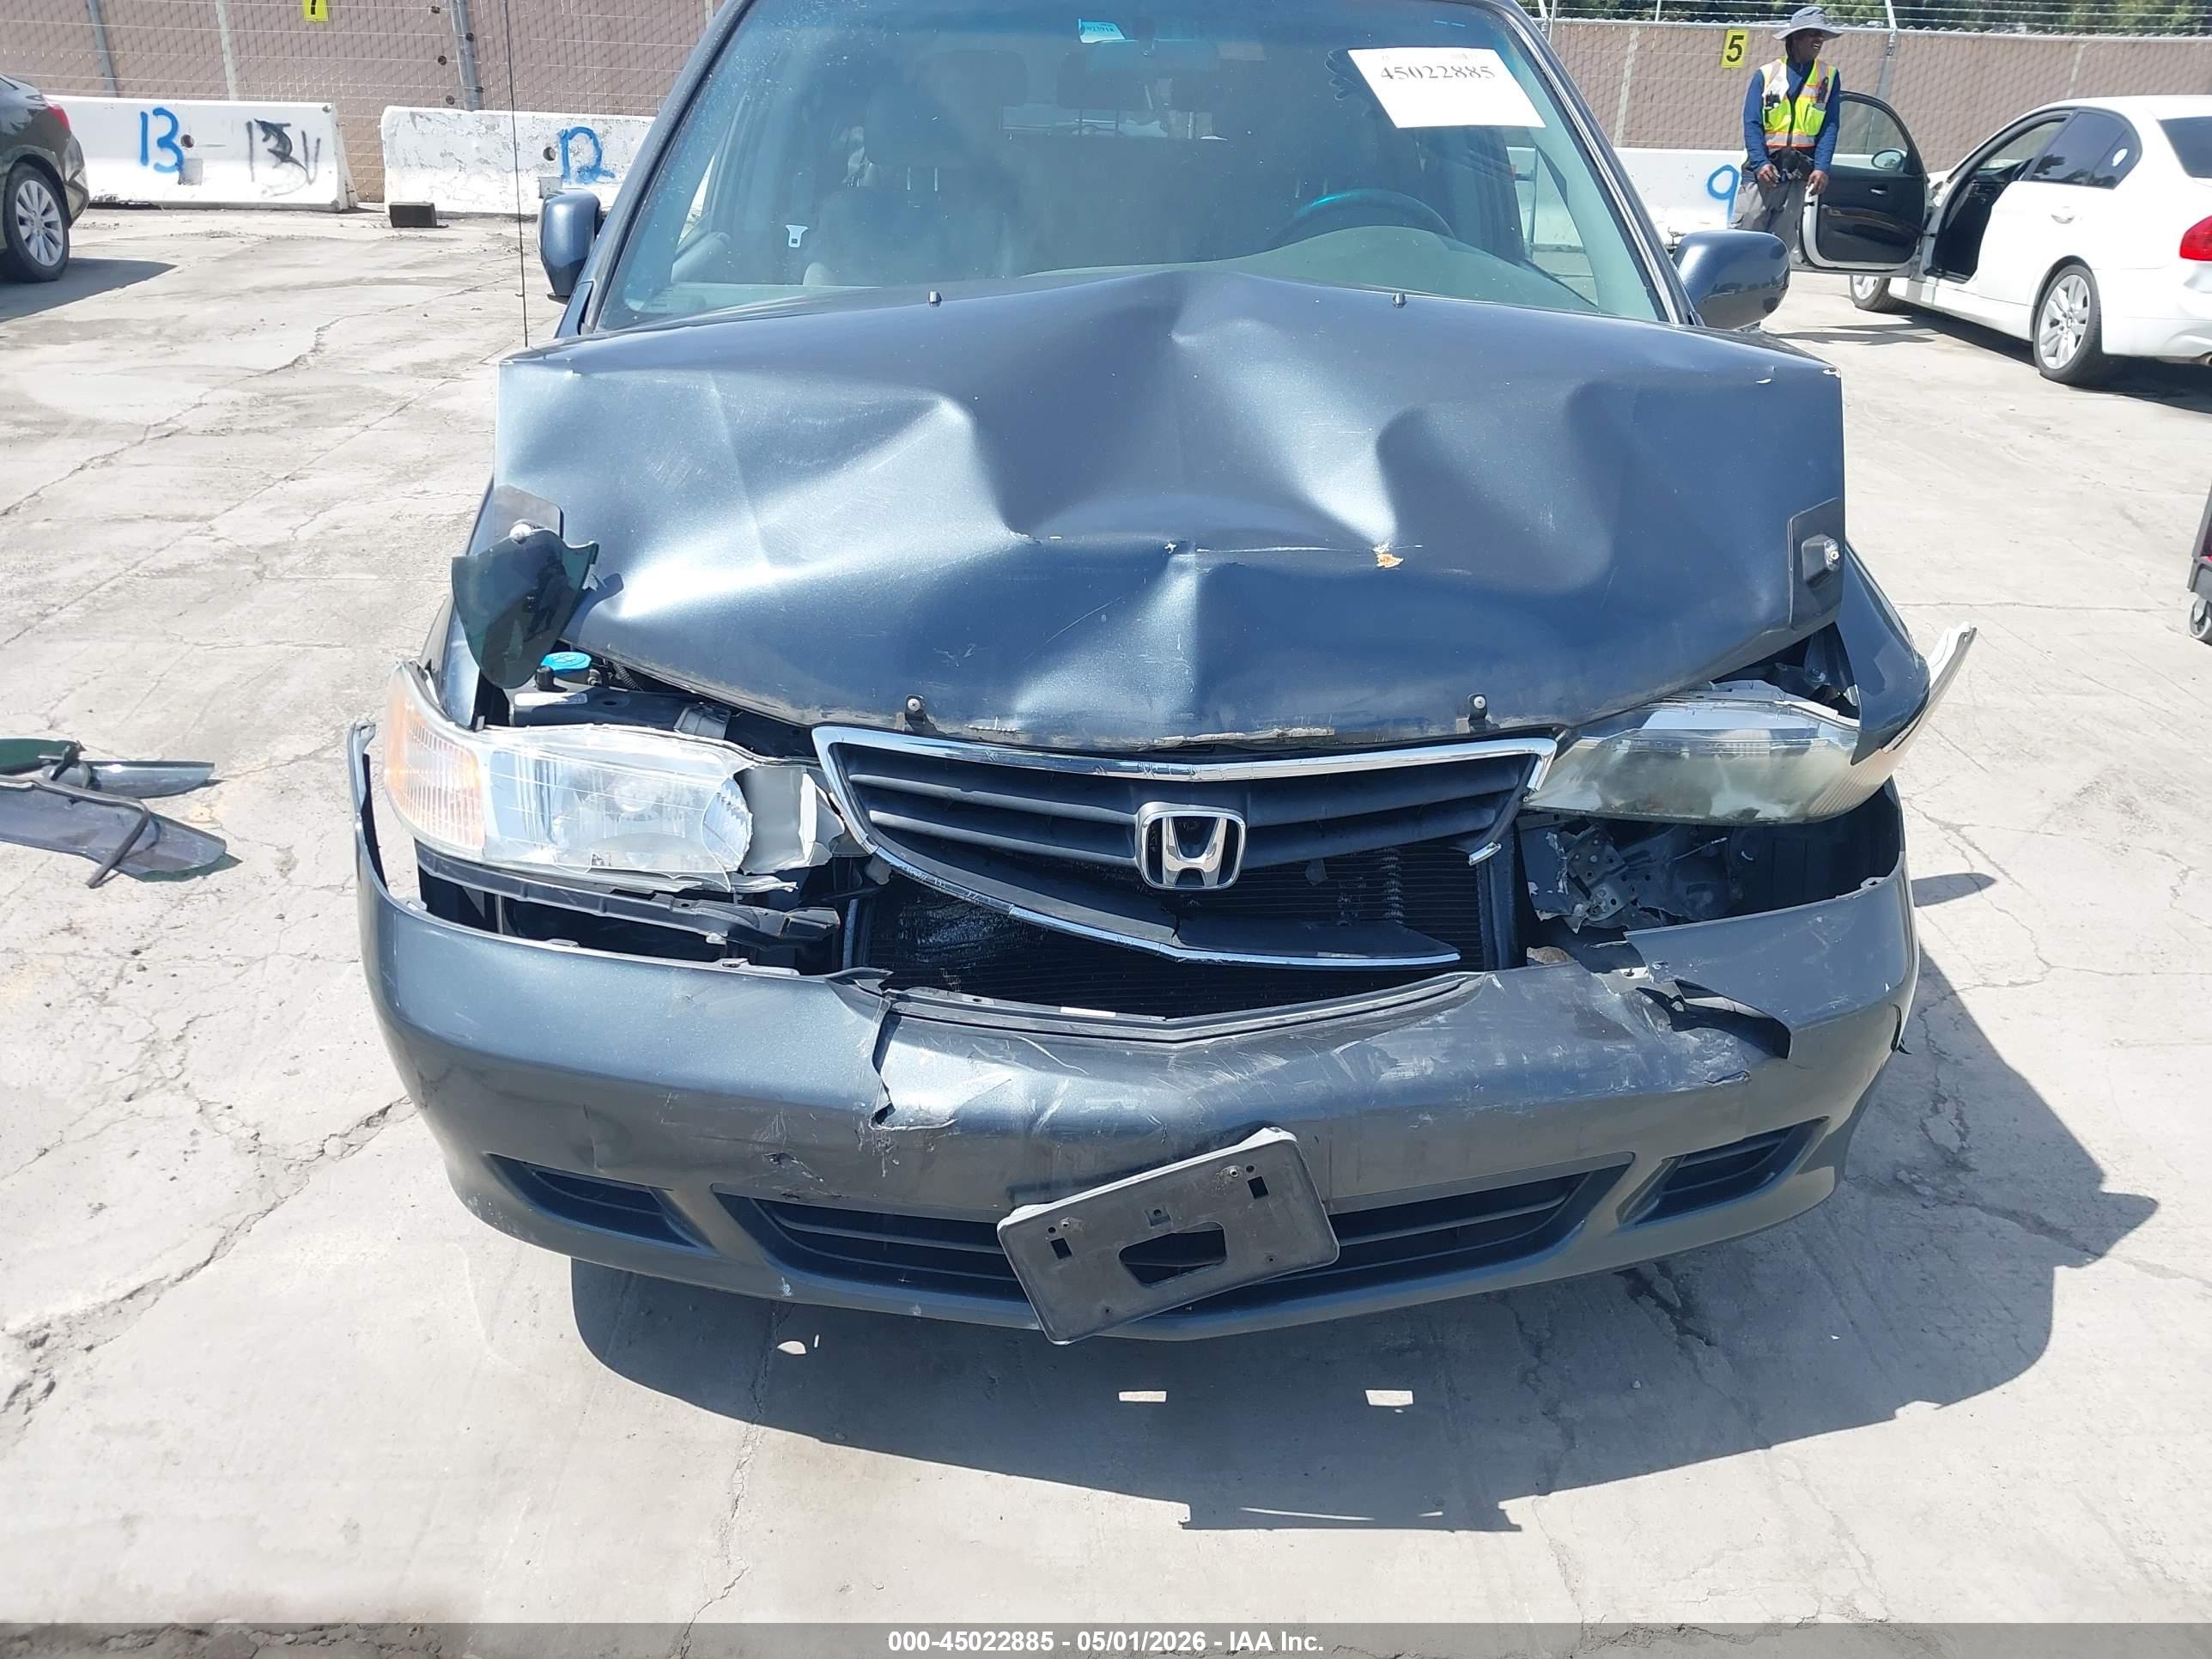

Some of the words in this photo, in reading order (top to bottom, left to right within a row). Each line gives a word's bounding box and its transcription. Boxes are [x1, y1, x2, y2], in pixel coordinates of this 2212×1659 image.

[1726, 35, 1745, 63] 5
[1380, 65, 1496, 80] 45022885
[140, 107, 184, 172] 13
[1707, 164, 1740, 225] 9
